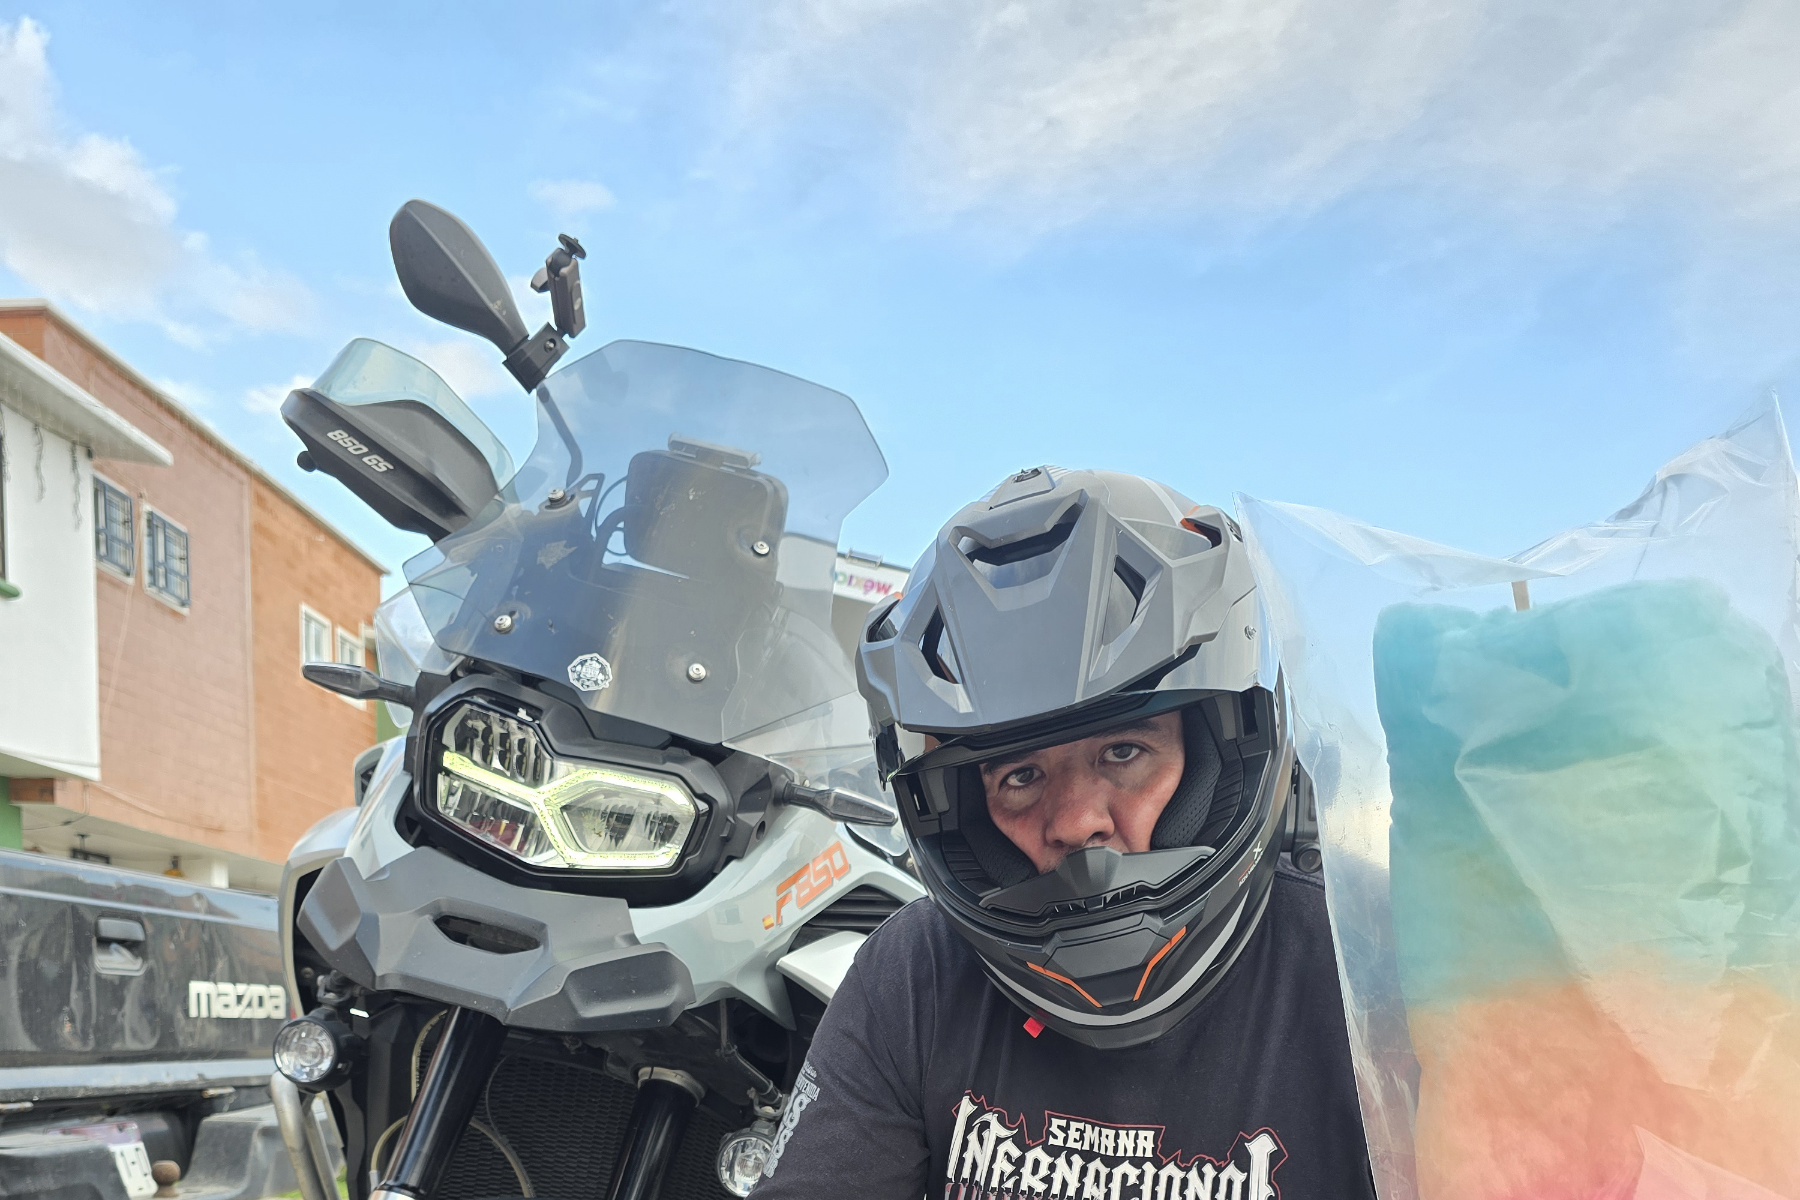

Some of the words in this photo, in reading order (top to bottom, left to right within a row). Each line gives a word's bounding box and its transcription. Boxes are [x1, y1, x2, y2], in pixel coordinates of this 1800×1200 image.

[326, 429, 369, 455] 850
[361, 454, 395, 473] GS
[776, 840, 851, 925] F850
[188, 980, 287, 1019] mazda
[1048, 1118, 1155, 1158] SEMANA
